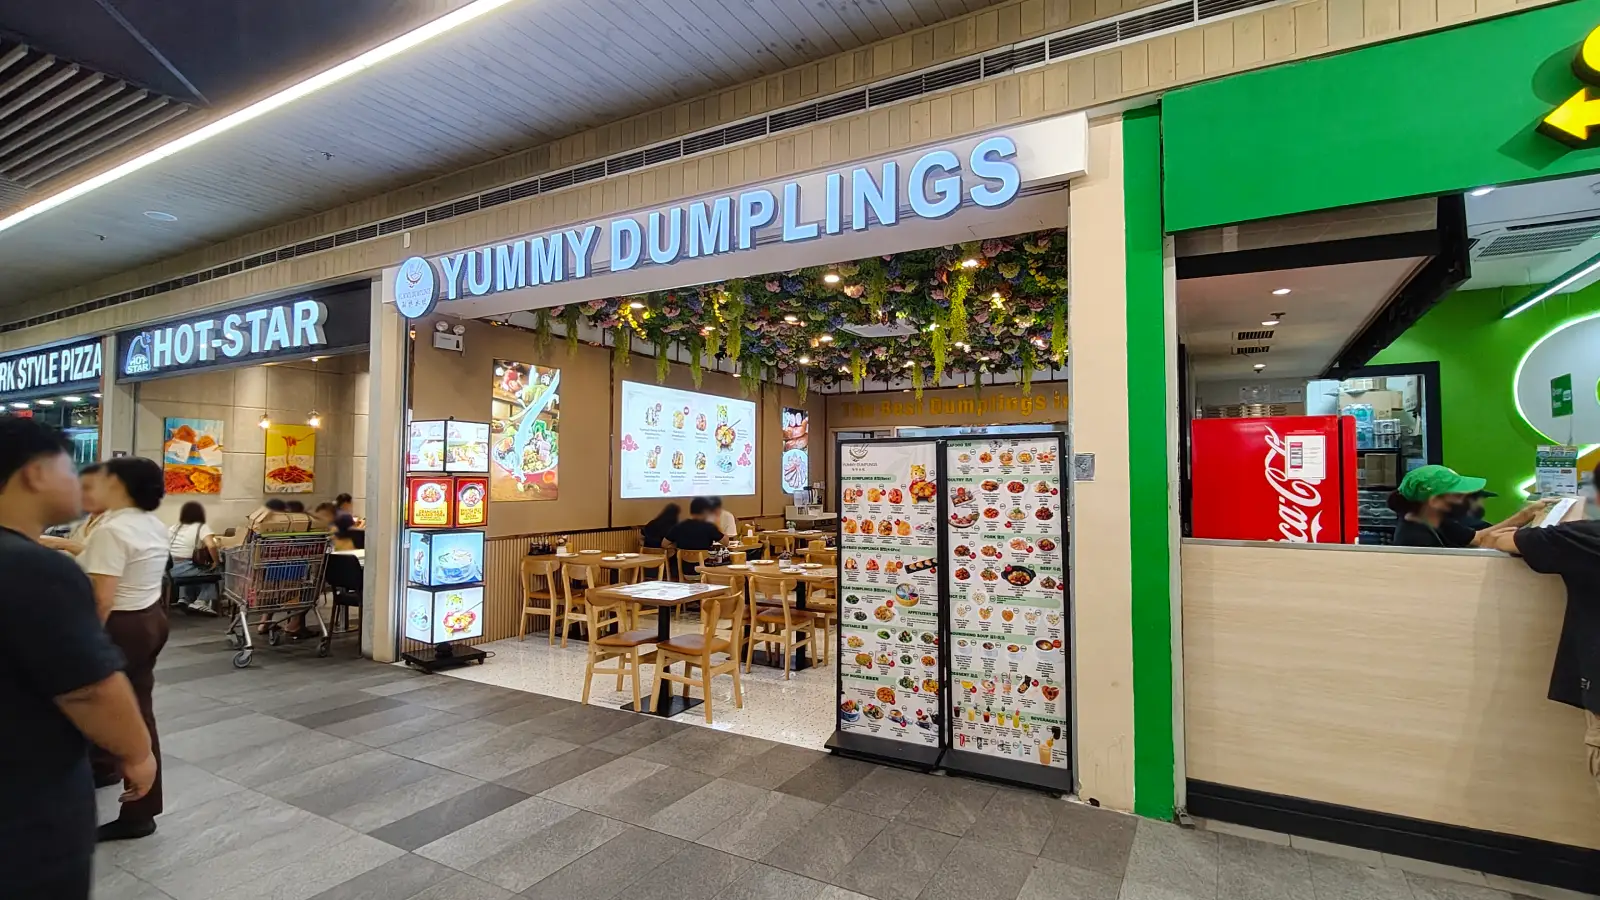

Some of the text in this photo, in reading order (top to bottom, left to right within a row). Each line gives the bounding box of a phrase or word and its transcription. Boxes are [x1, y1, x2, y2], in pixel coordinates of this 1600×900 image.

[440, 136, 1022, 301] YUMMY DUMPLINGS
[153, 299, 322, 368] HOT-STAR
[17, 352, 59, 390] STYLE
[60, 342, 102, 383] PIZZA
[127, 363, 149, 373] STAR
[842, 401, 875, 419] The
[881, 398, 924, 417] Best
[929, 393, 1048, 417] Dumplings
